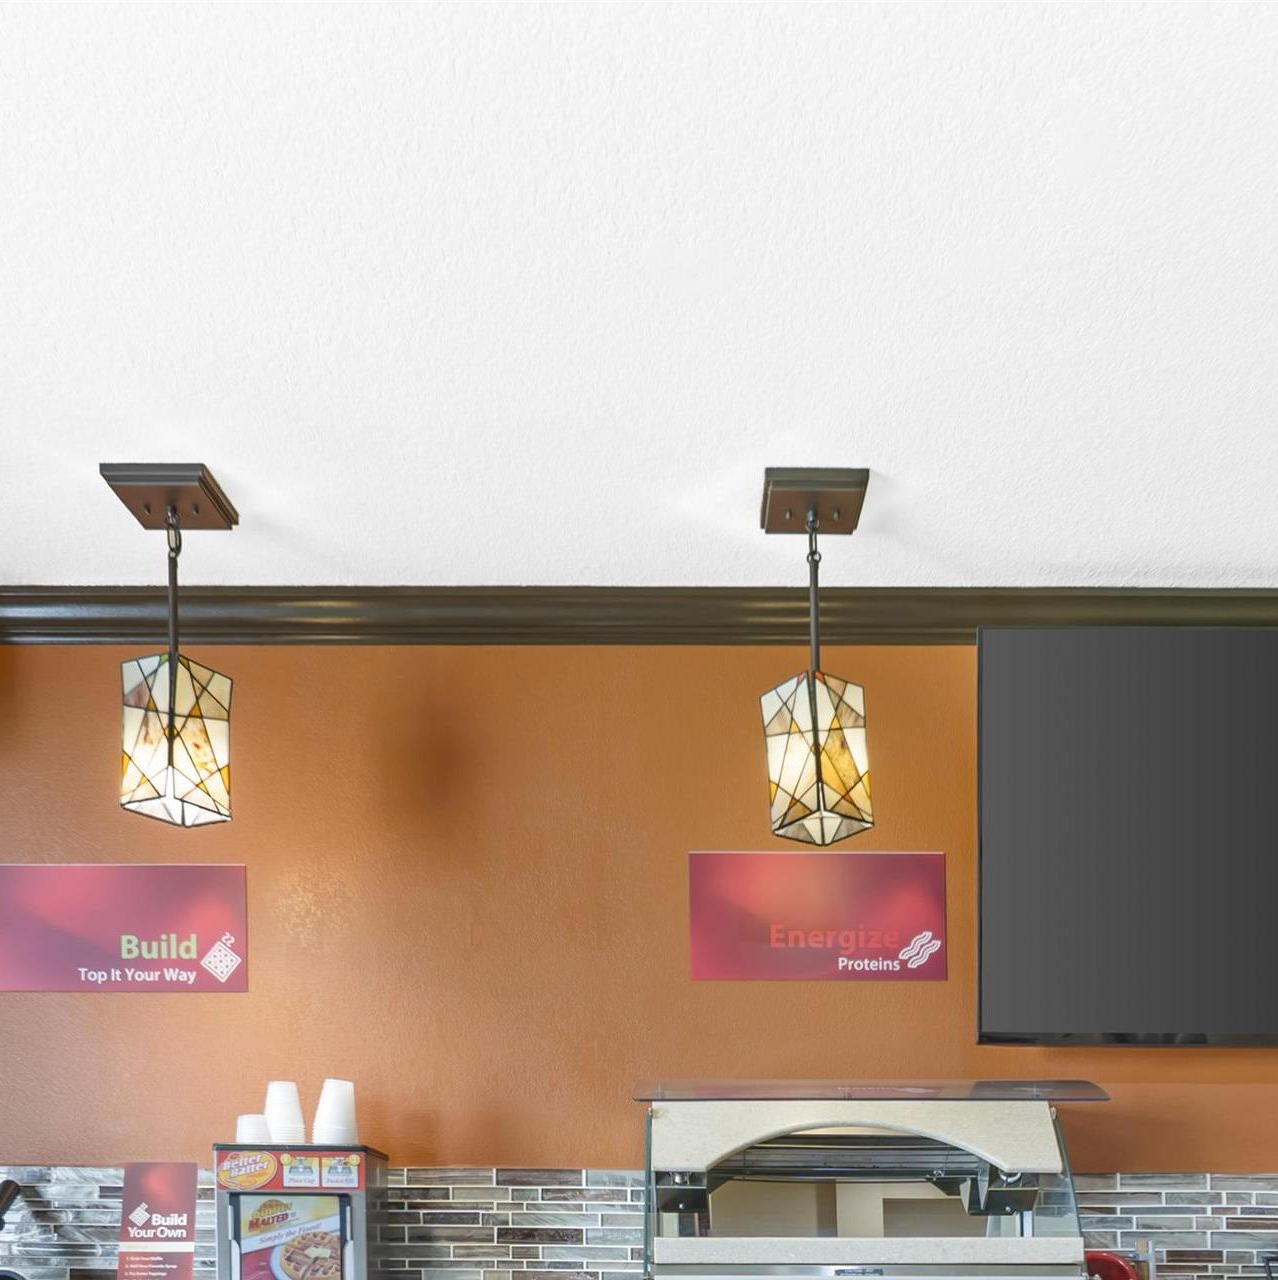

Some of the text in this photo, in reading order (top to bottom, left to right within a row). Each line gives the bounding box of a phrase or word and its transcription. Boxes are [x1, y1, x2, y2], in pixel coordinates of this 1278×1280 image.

[120, 934, 197, 960] Build
[770, 924, 899, 955] Energize
[838, 957, 900, 971] Proteins
[78, 968, 196, 984] Top It Your Way
[151, 1213, 187, 1226] Build
[128, 1227, 187, 1238] Your Own
